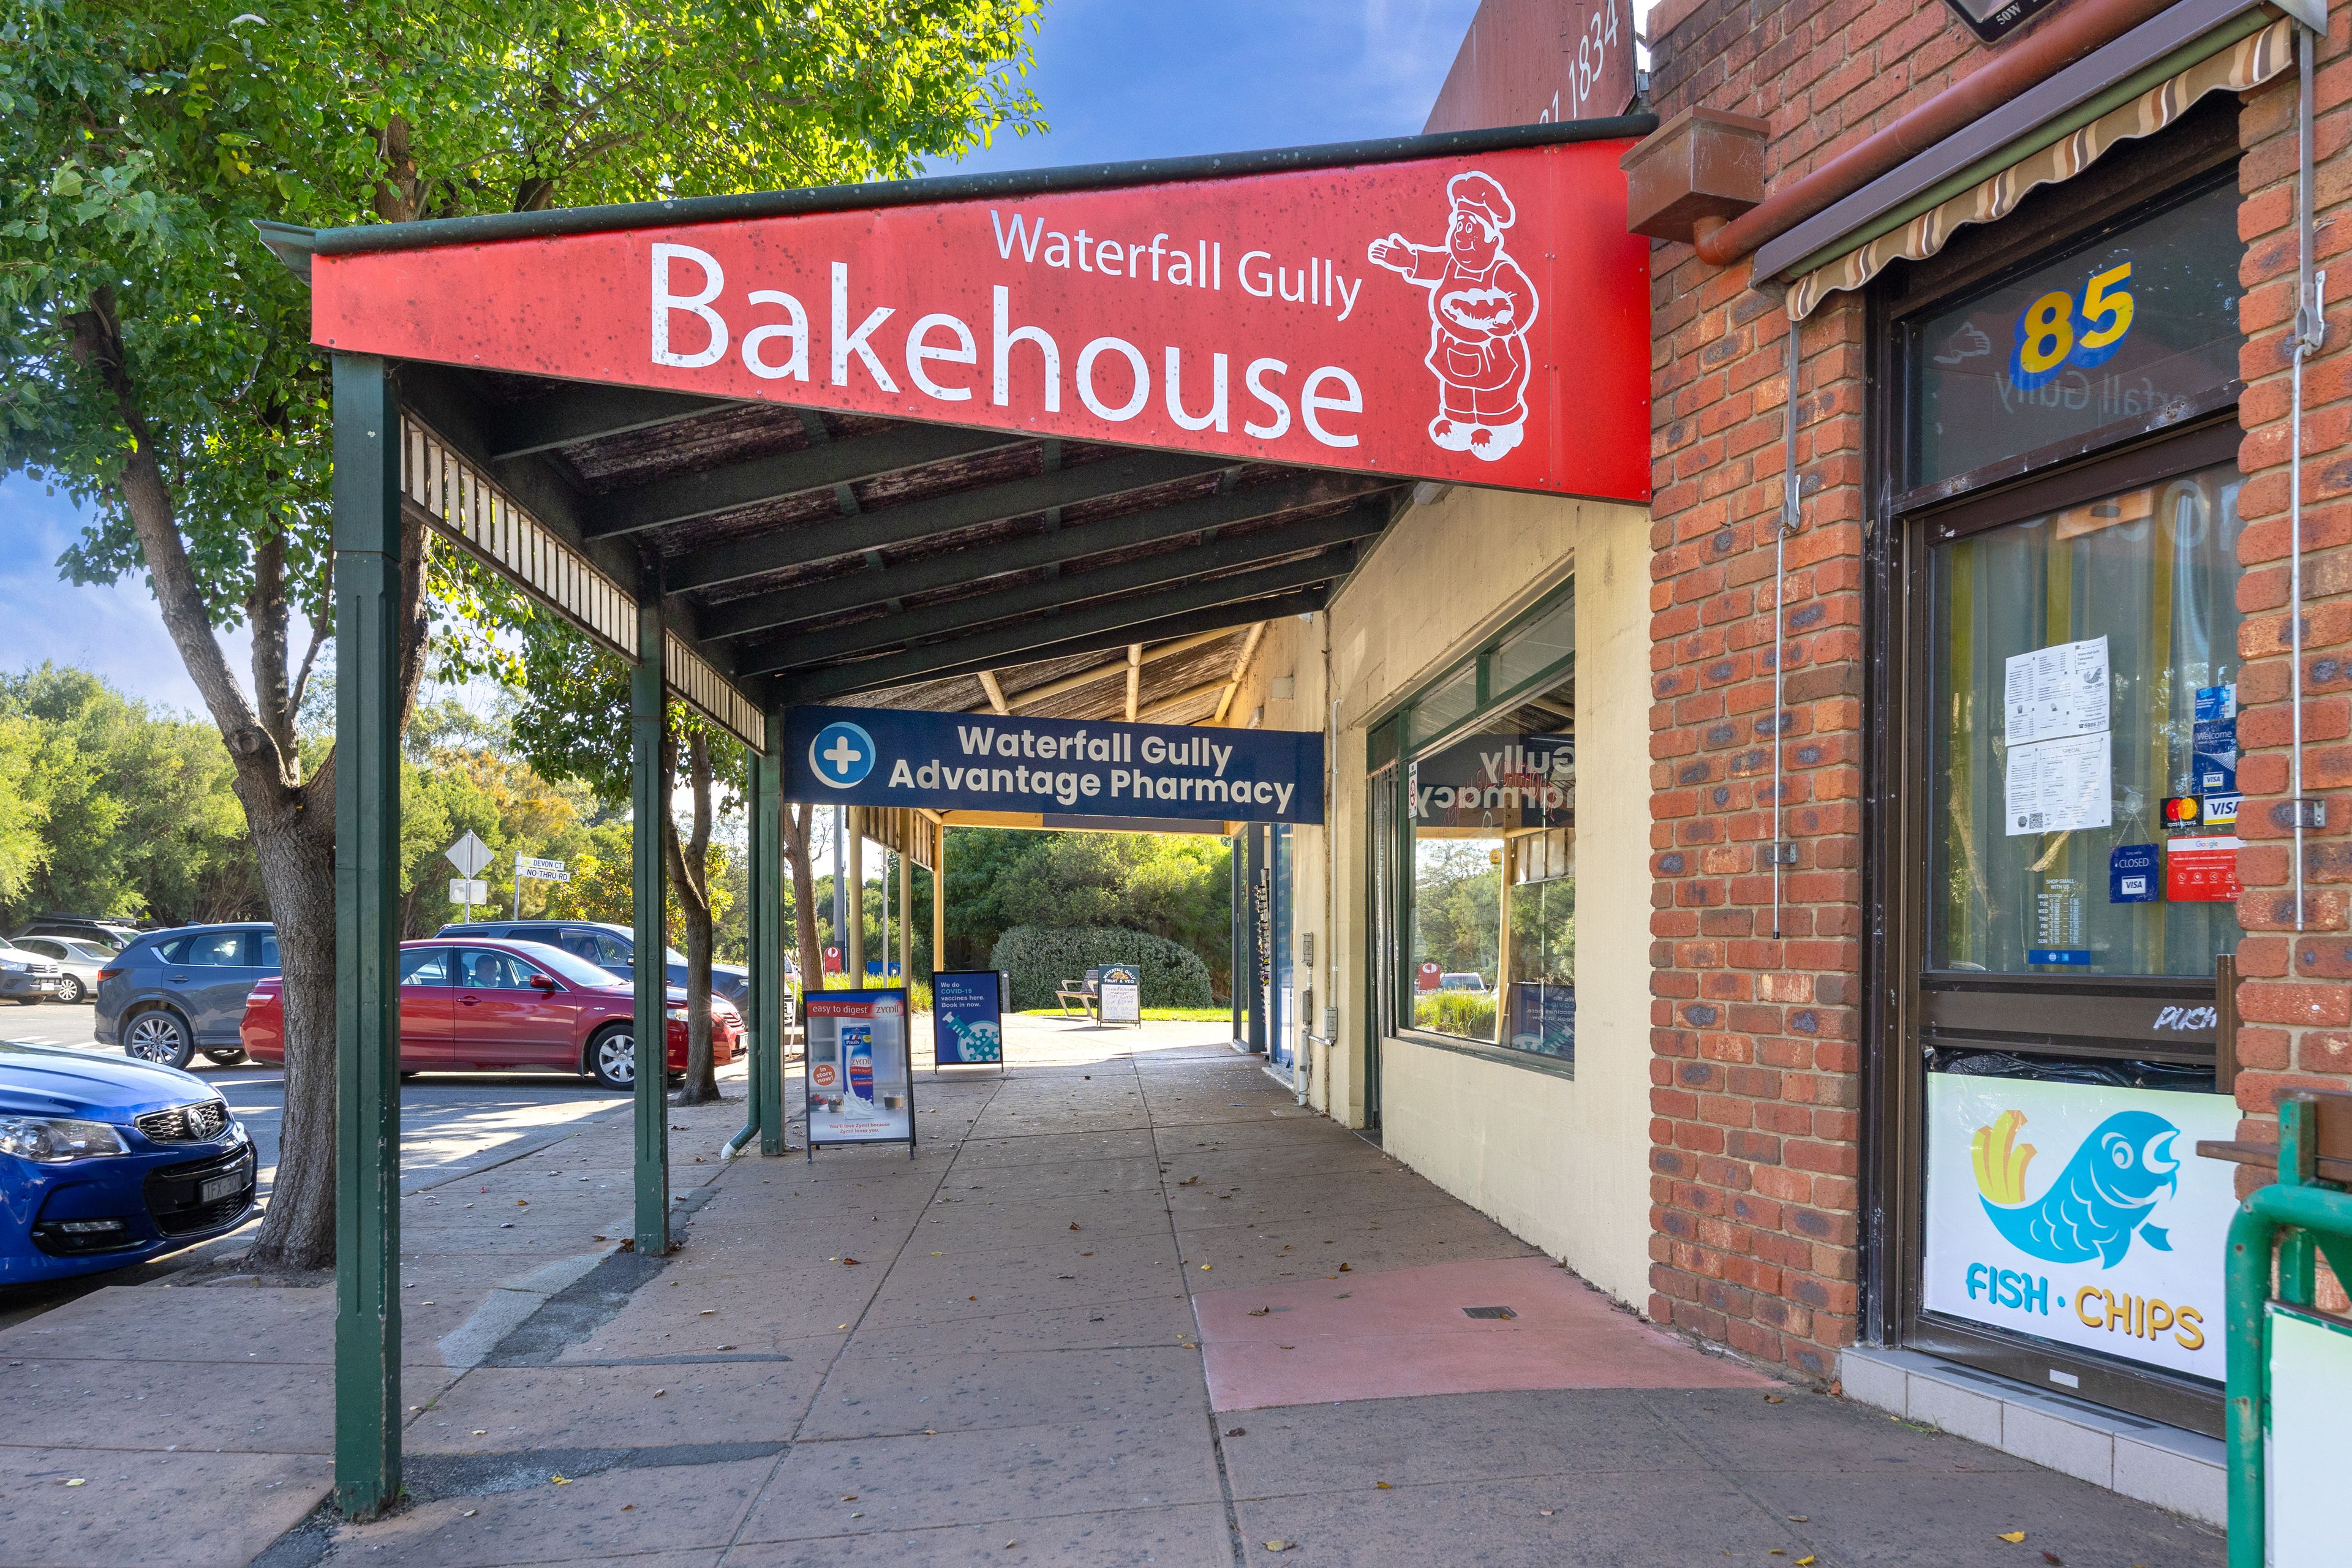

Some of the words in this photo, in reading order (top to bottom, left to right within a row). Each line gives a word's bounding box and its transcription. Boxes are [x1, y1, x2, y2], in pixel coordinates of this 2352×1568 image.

[1996, 2, 2022, 25] 50W
[1569, 0, 1619, 121] 1834
[989, 208, 1223, 291] Waterfall
[1237, 250, 1363, 322] Gully
[2021, 260, 2135, 375] 85
[651, 242, 1364, 448] Bakehouse
[2196, 730, 2233, 741] Welcome
[957, 725, 1131, 763] Waterfall
[1140, 736, 1234, 777] Gully
[888, 758, 1101, 805] Advantage
[1110, 768, 1295, 815] Pharmacy
[2195, 840, 2218, 849] Google
[533, 859, 553, 868] DEVON
[2119, 858, 2149, 869] CLOSED
[2125, 880, 2143, 889] VISA
[1103, 968, 1123, 979] WATERFALL
[1125, 970, 1136, 979] GULLY
[812, 1005, 831, 1016] easy
[1966, 1262, 2048, 1316] FISH
[2074, 1284, 2204, 1351] CHIPS
